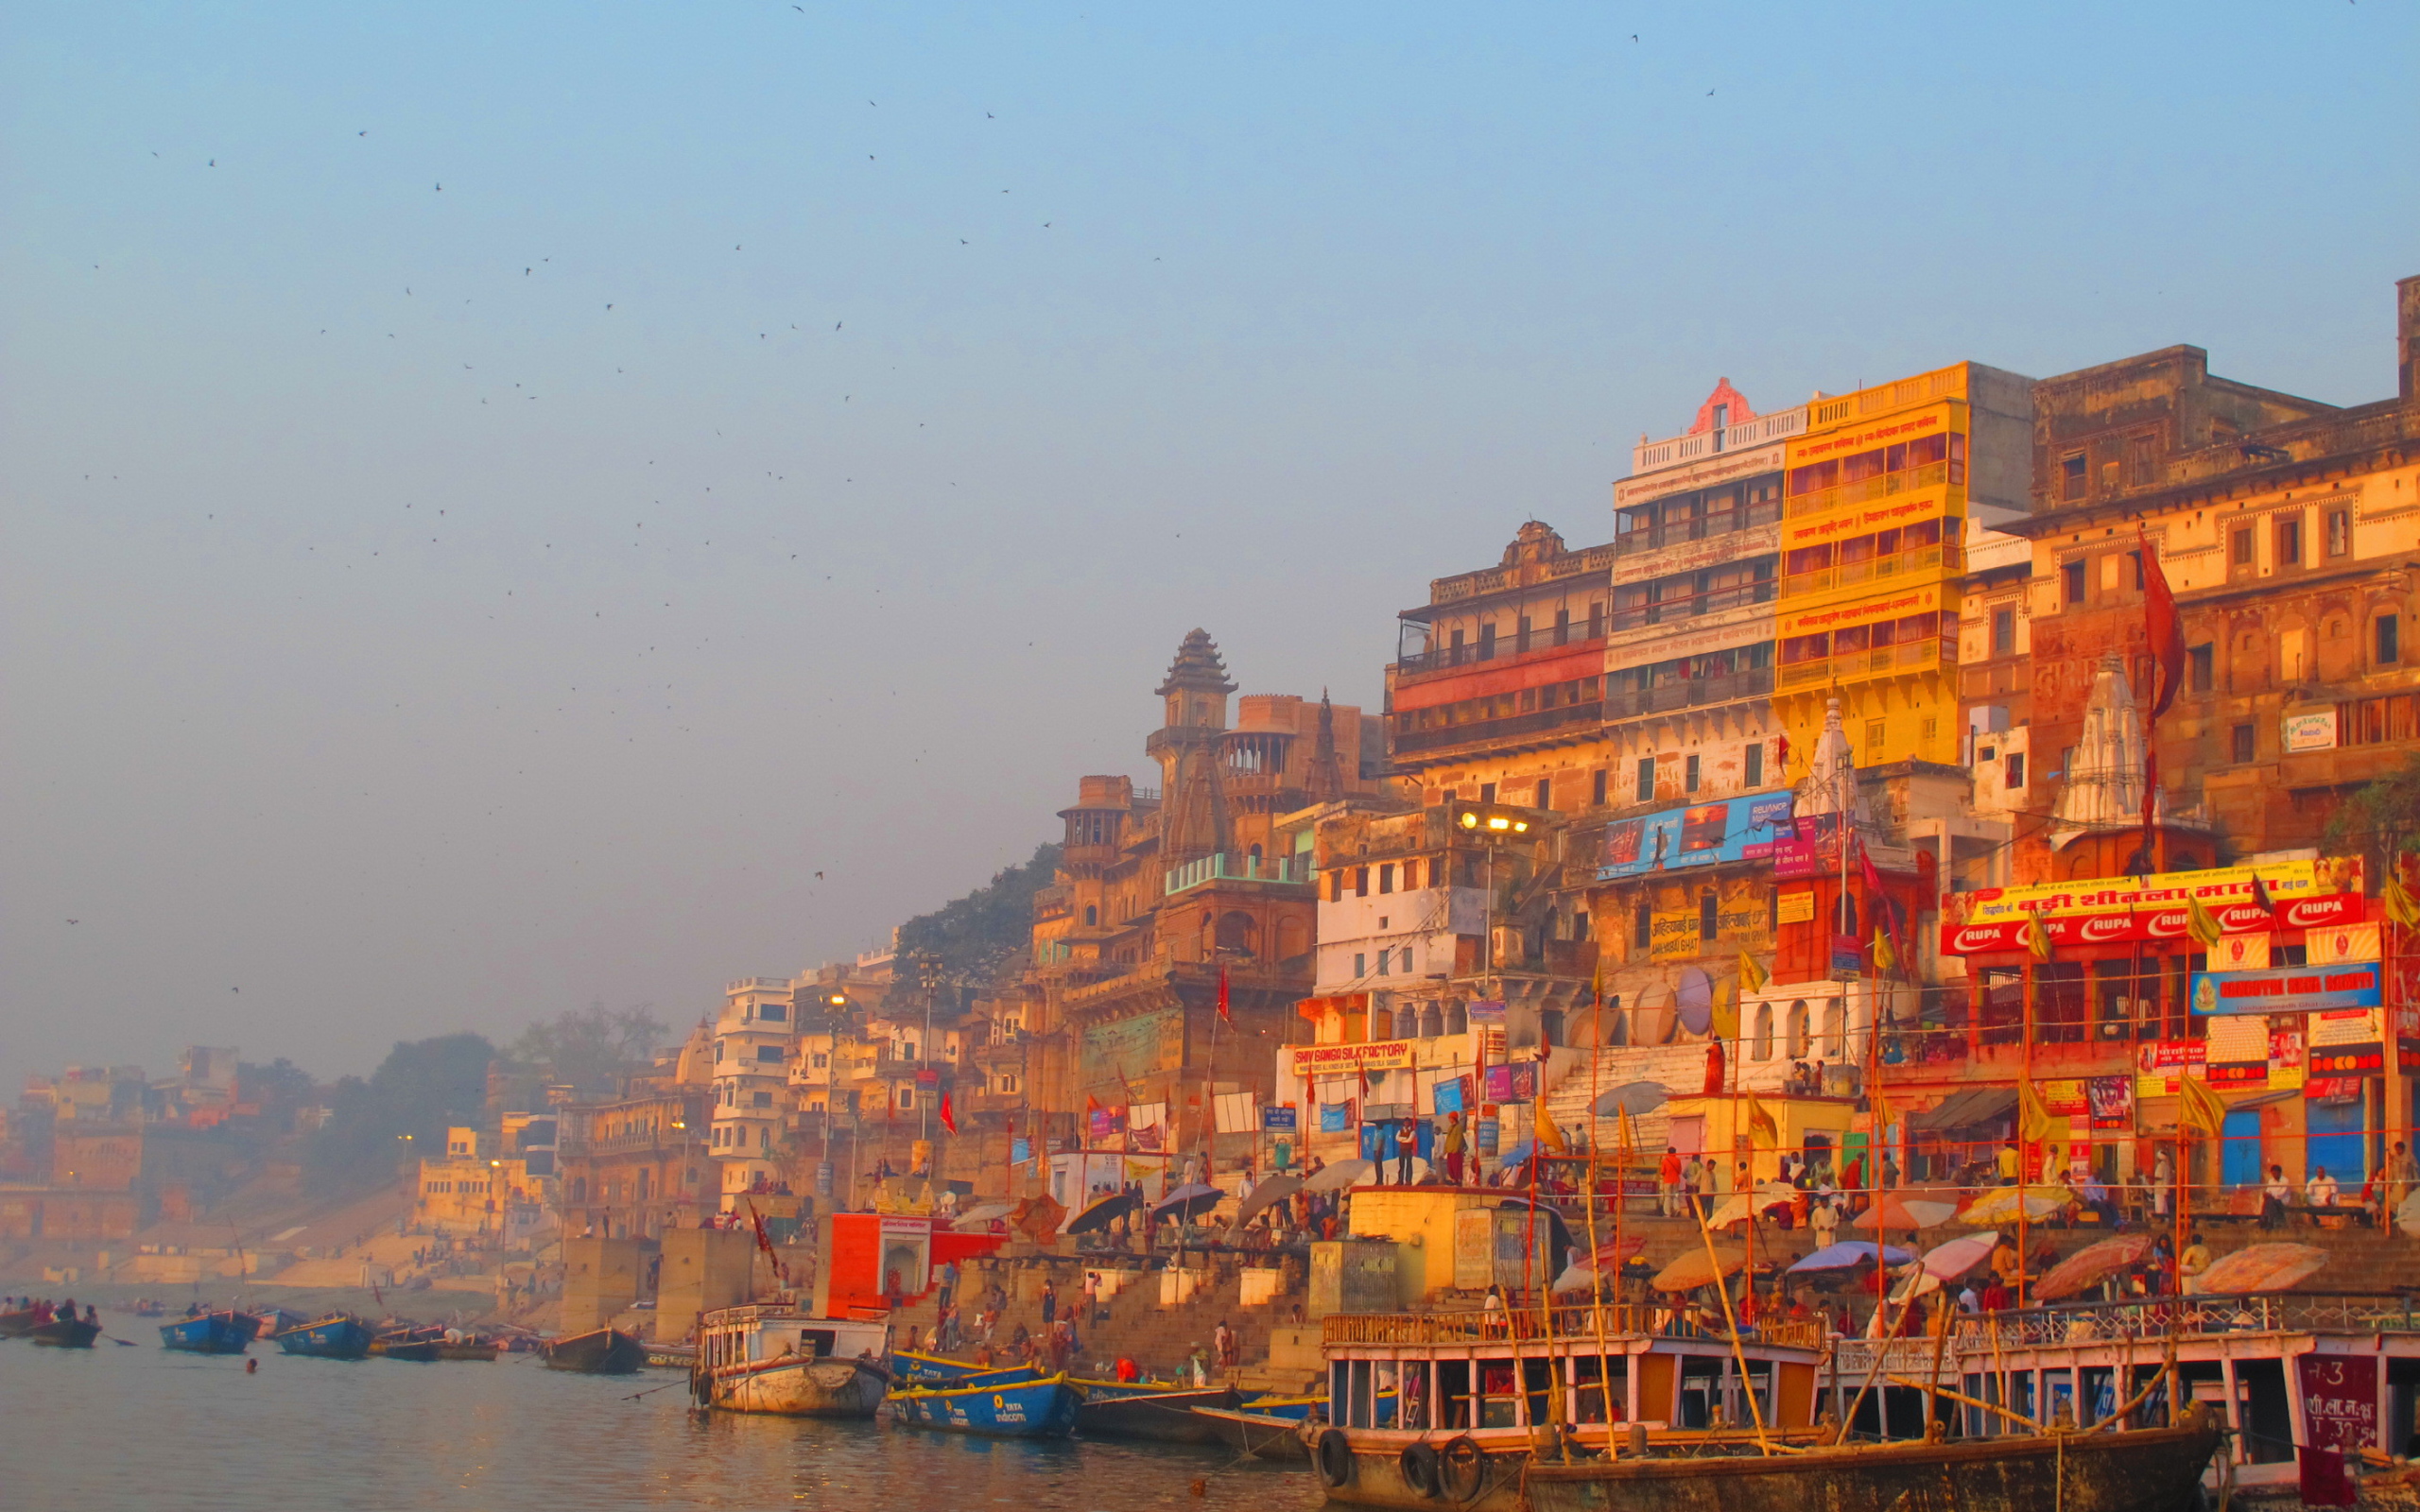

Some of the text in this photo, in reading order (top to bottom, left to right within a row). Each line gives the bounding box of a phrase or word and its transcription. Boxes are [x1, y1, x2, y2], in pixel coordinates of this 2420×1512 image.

[2231, 907, 2271, 920] RUPA
[2301, 902, 2342, 915] RUPA
[2094, 919, 2132, 930] RUPA
[2161, 915, 2187, 926] RUP
[1966, 929, 2001, 941] RUPA
[1681, 937, 1698, 952] GHAT
[1314, 1047, 1340, 1062] GANGA
[1342, 1045, 1362, 1059] SILK
[1362, 1043, 1408, 1058] FACTORY
[2310, 1054, 2382, 1073] DOCOMO
[2326, 1361, 2344, 1385] 3
